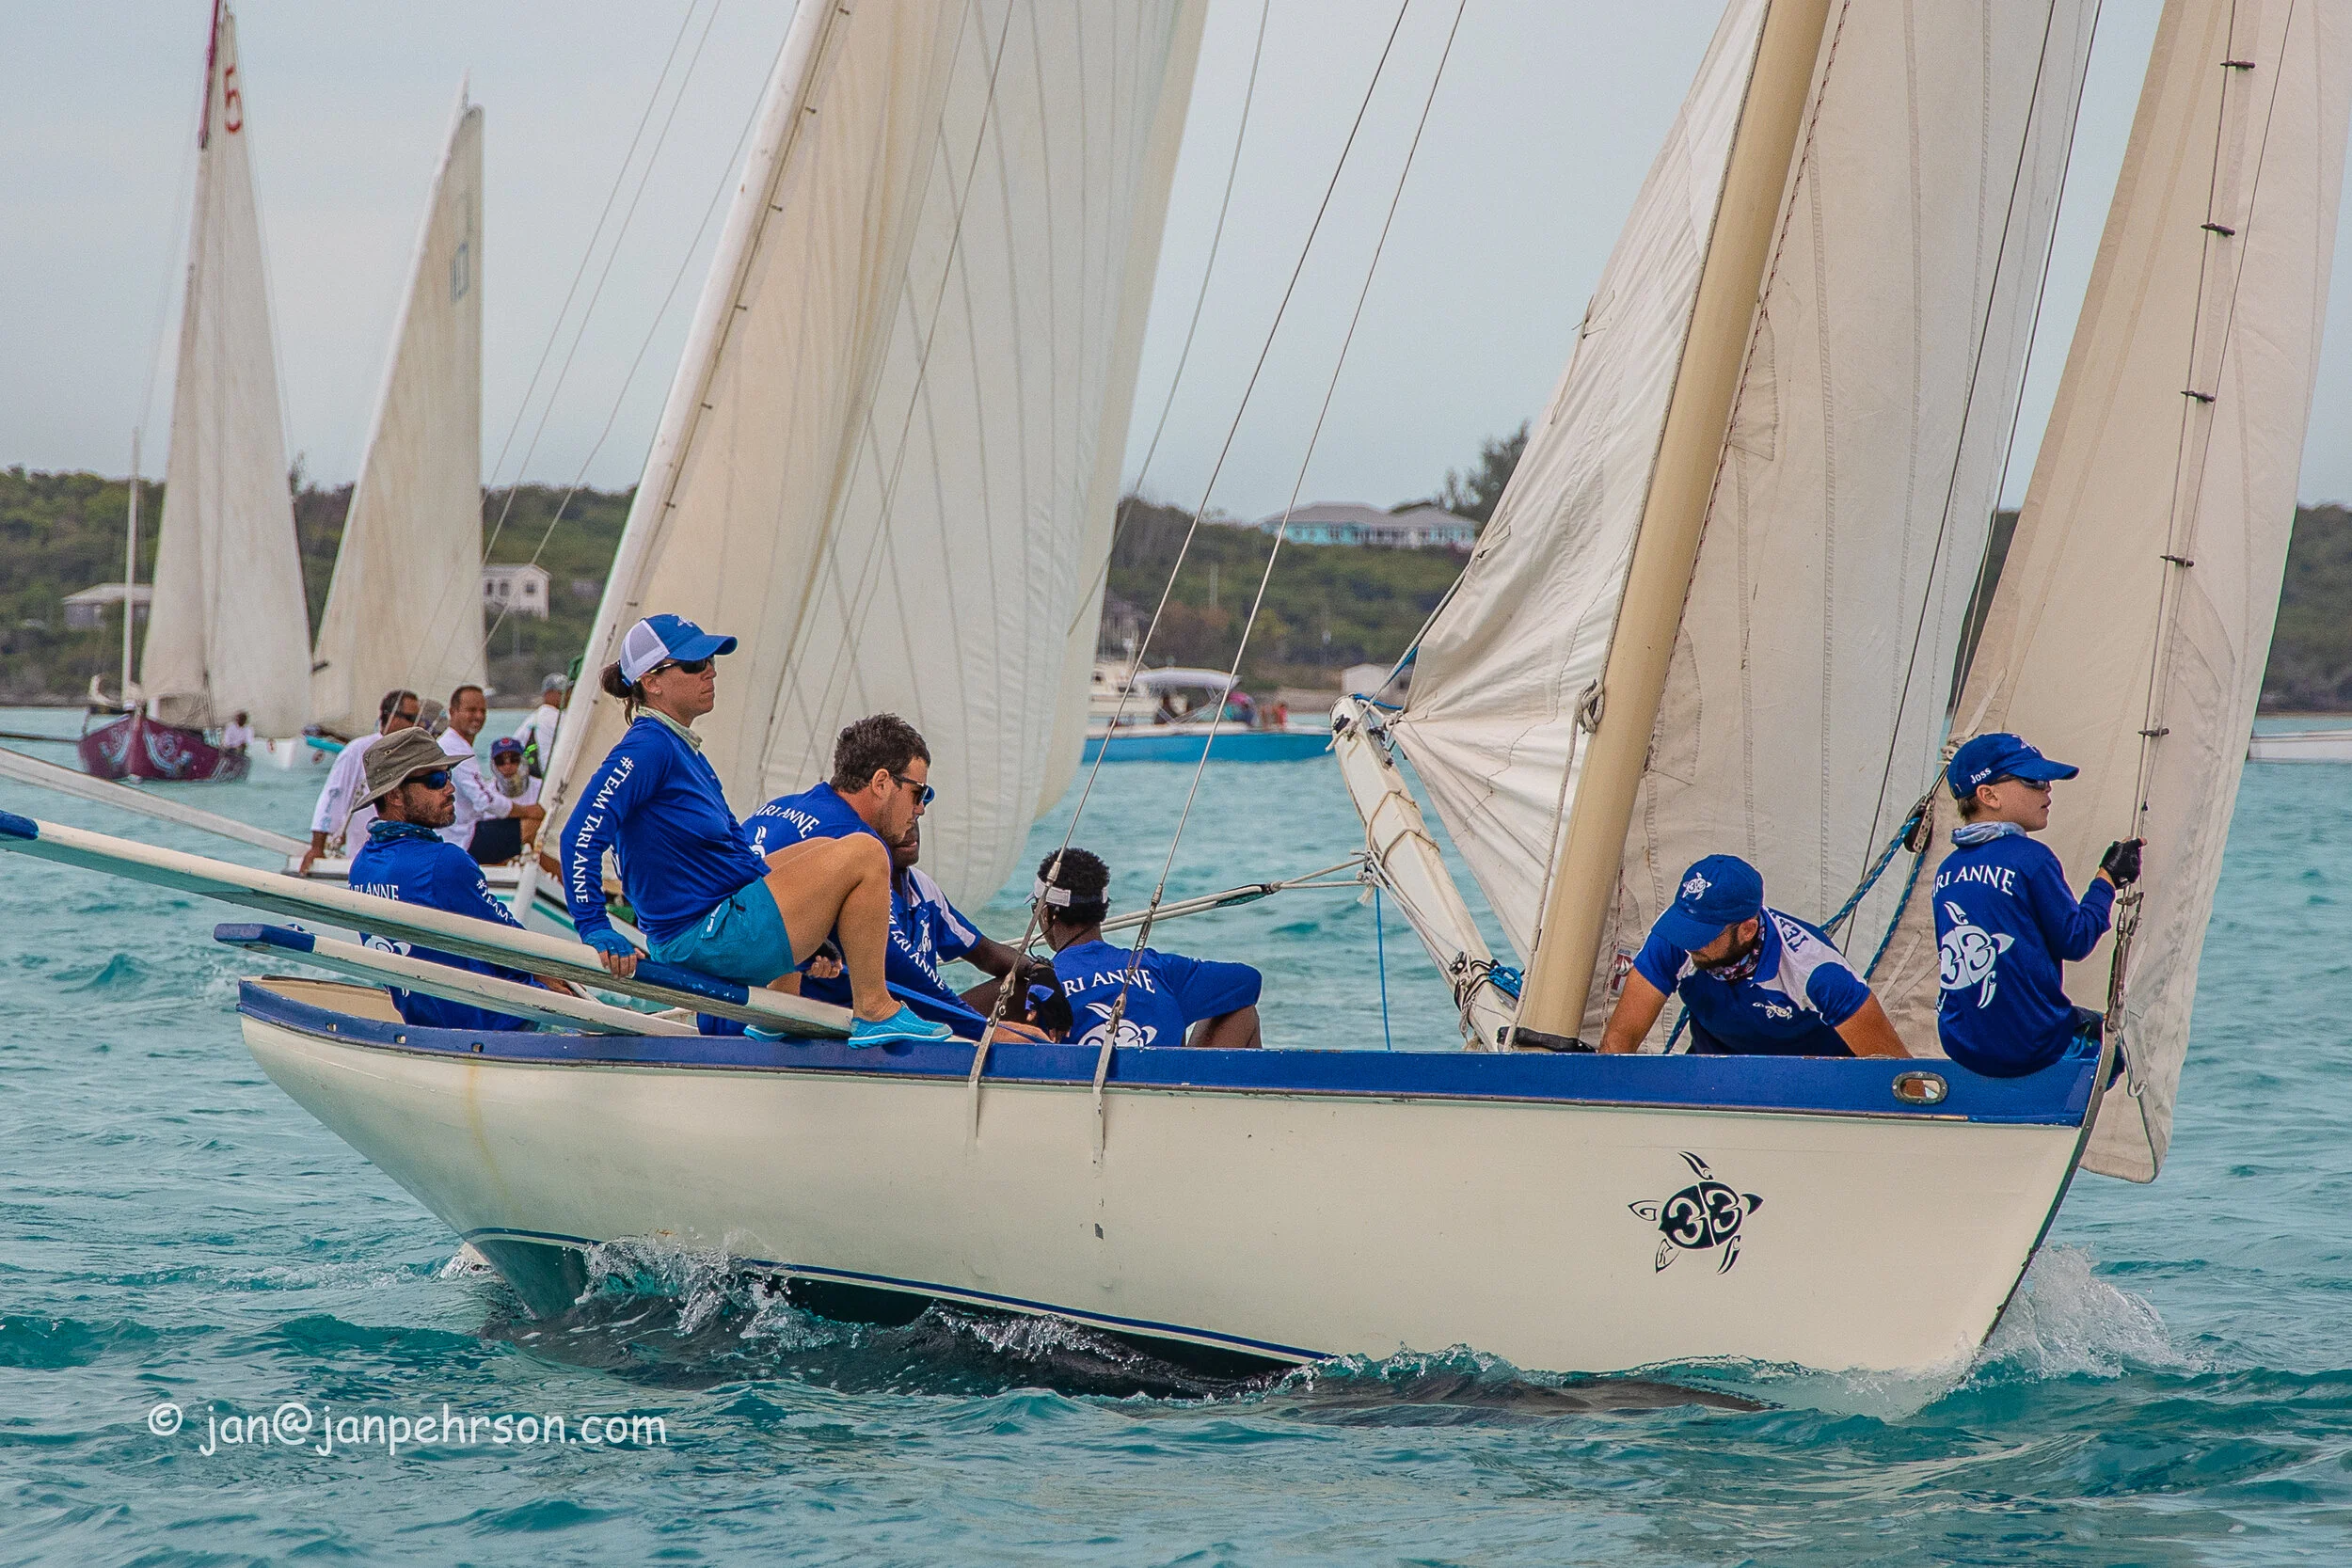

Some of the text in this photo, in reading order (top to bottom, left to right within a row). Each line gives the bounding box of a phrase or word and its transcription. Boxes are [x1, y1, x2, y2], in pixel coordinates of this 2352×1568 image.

[223, 63, 244, 135] 5
[1970, 767, 1993, 784] Joss
[572, 755, 635, 904] #TEAM TARI ANNE
[775, 807, 820, 840] ANNE
[1932, 864, 2016, 898] RI ANNE
[908, 950, 946, 990] ANNE
[1090, 969, 1156, 995] ANNE
